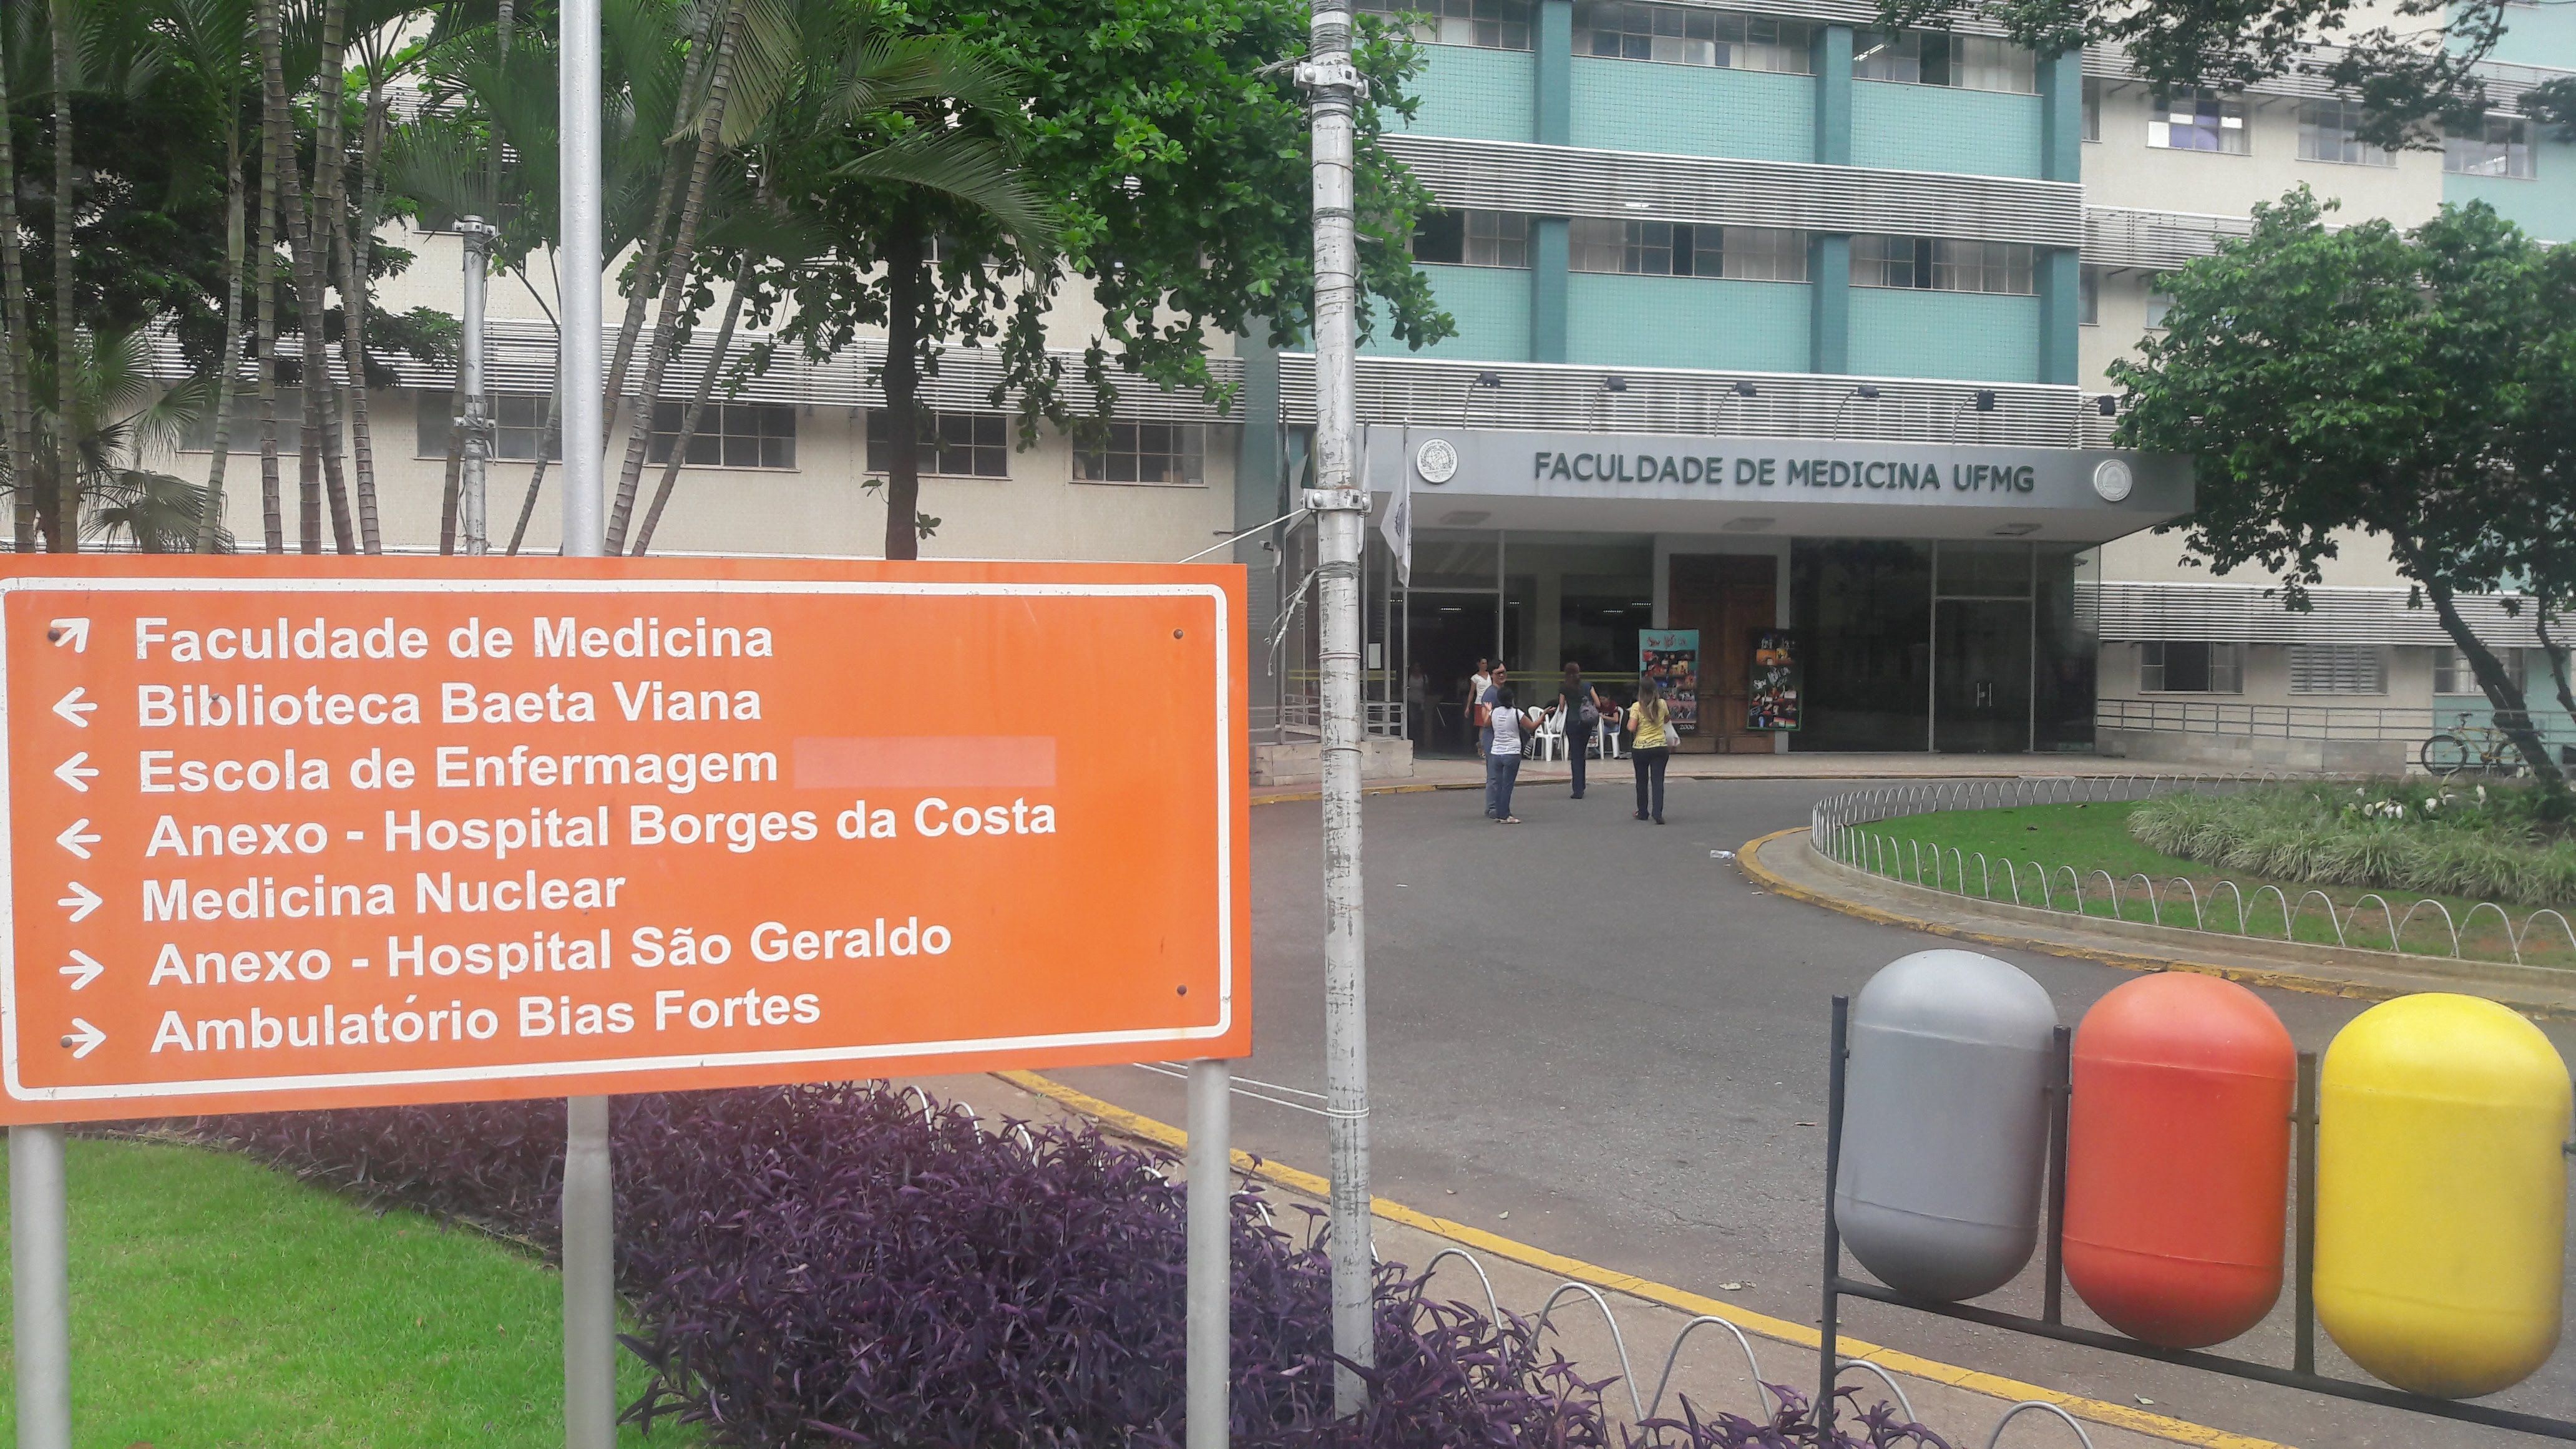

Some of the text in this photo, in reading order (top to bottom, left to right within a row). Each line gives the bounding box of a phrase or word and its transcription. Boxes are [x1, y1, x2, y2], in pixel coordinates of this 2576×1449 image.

[1534, 452, 2035, 492] FACULDADE DE MEDICINA UFMG
[136, 617, 773, 662] Faculdade de Medicina
[139, 681, 761, 727] Biblioteca Baeta Viana
[140, 745, 777, 794] Escola de Enfermagem
[145, 815, 327, 857] Anexo
[386, 806, 608, 859] Hospital
[630, 805, 817, 853] Borges
[837, 800, 896, 839] da
[914, 798, 1056, 837] Costa
[143, 869, 626, 922] Medicina Nuclear
[149, 944, 331, 986] Anexo
[388, 929, 610, 980] Hospital
[631, 927, 731, 967] São
[751, 917, 951, 962] Geraldo
[150, 988, 820, 1053] Ambulatório Bias Fortes
